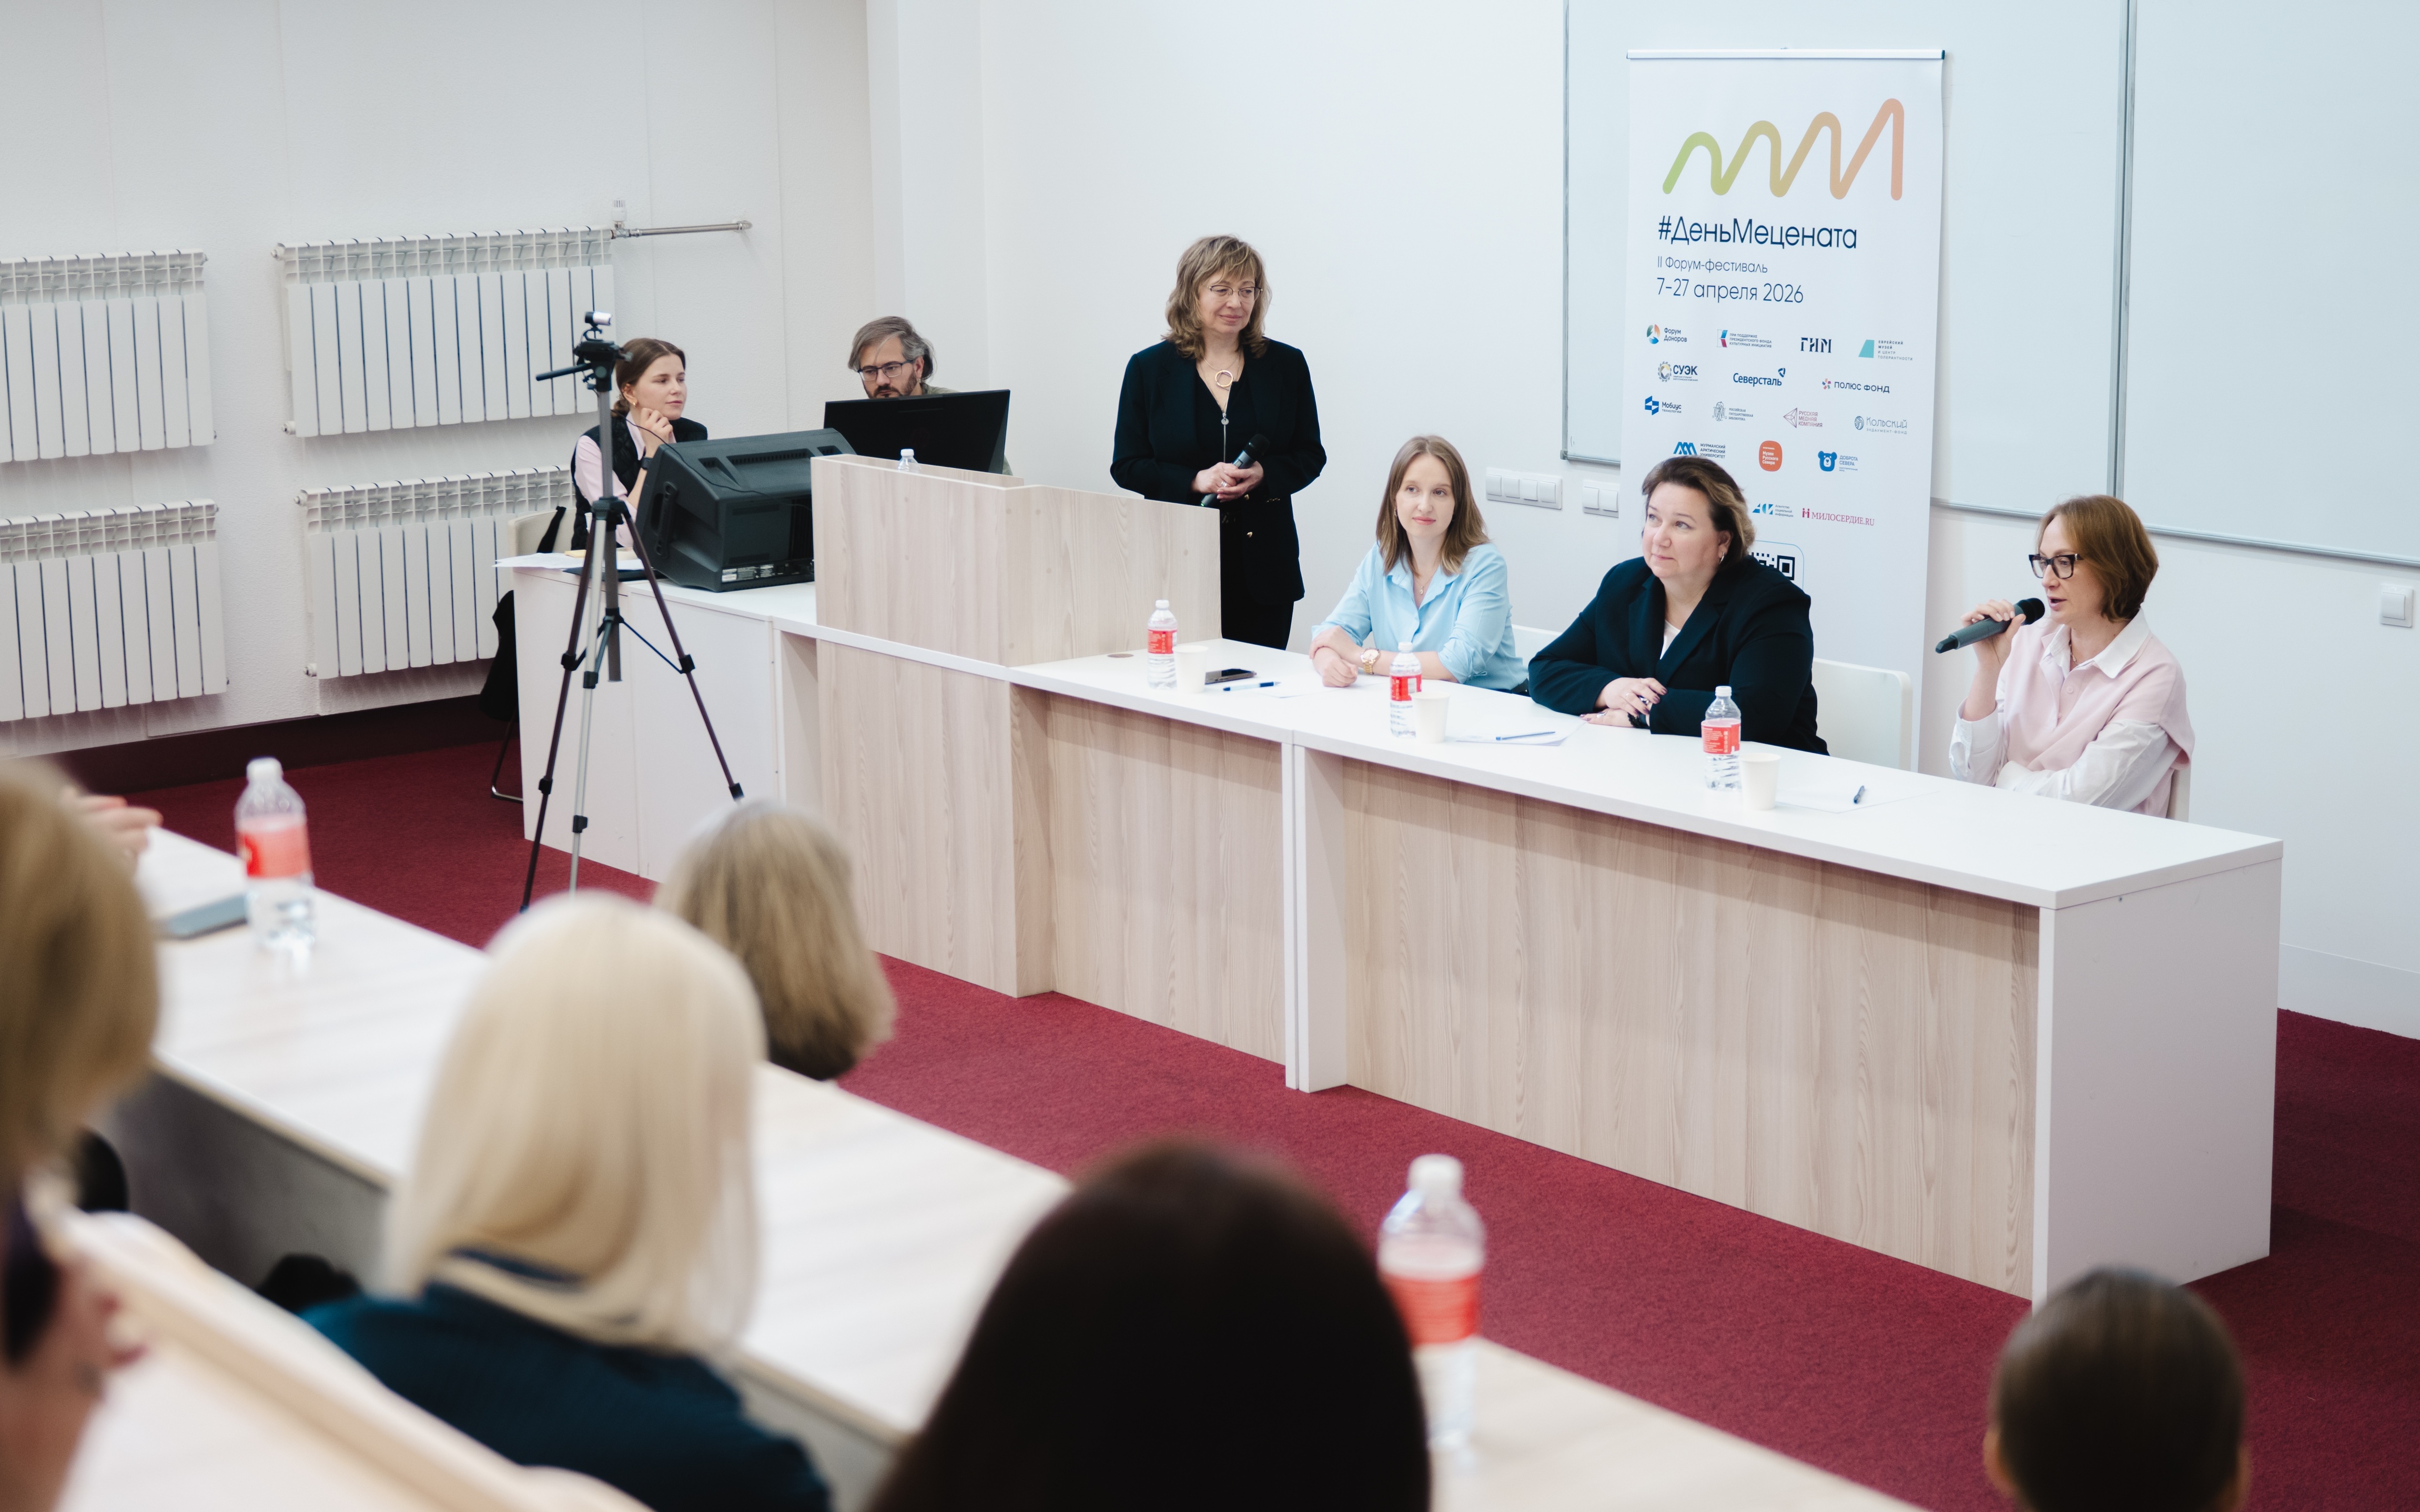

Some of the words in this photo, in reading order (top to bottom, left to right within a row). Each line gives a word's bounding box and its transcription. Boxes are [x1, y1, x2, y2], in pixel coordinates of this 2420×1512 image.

[1658, 215, 1858, 249] #ДеньМецената
[1665, 256, 1768, 273] Форум-фестиваль
[1694, 283, 1757, 303] апреля
[1763, 282, 1803, 303] 2026
[1800, 337, 1831, 353] ГИМ
[1673, 364, 1698, 376] СУЭК
[1733, 373, 1782, 387] Северсталь
[1834, 381, 1861, 390] ПОЛЮС
[1864, 384, 1890, 393] ФОНД
[1662, 401, 1682, 410] Мобиус
[1866, 417, 1907, 429] Кольский
[1811, 512, 1875, 526] МИЛОСЕРДИЕ.RU
